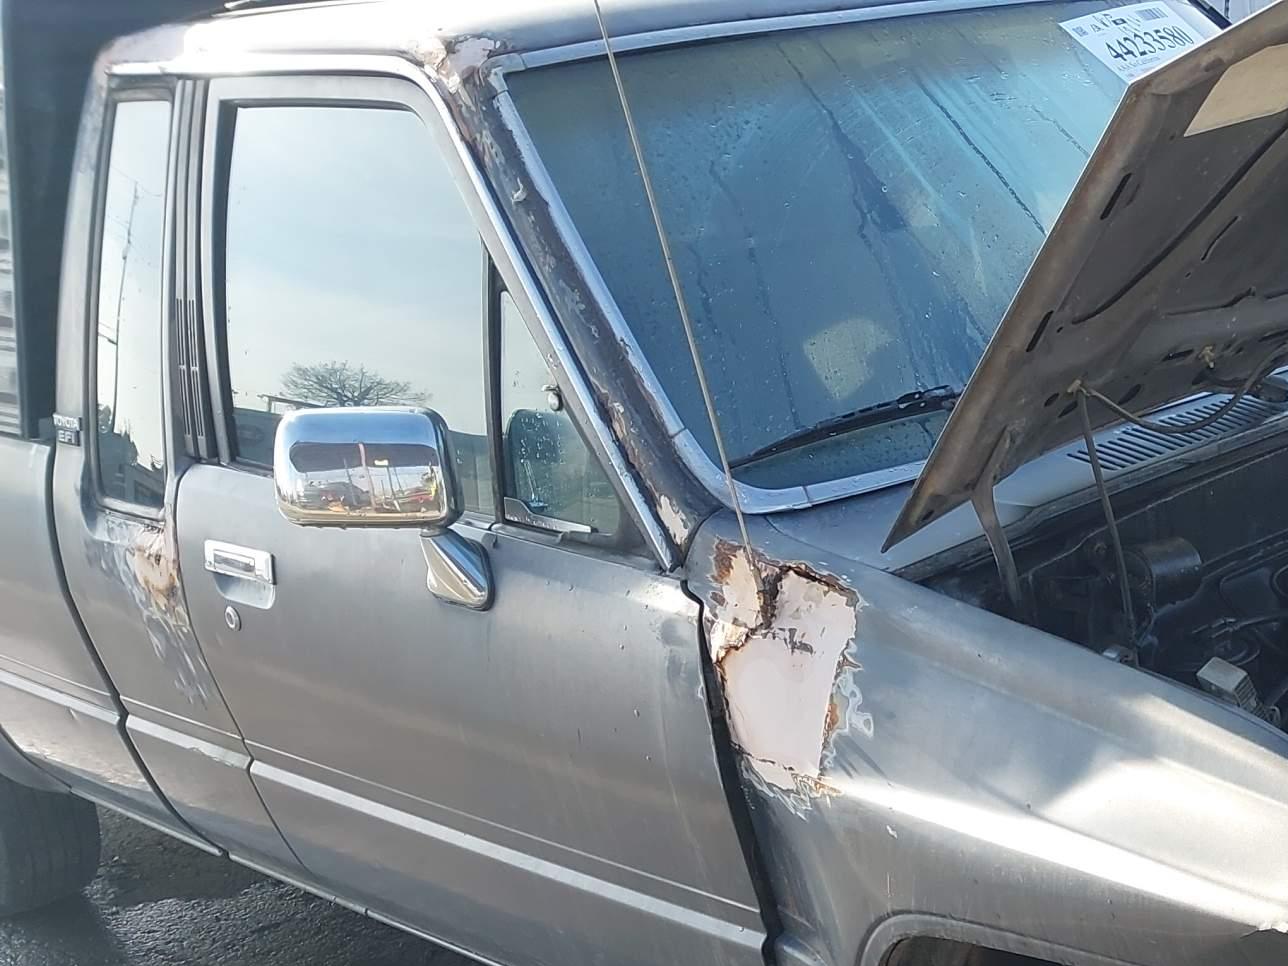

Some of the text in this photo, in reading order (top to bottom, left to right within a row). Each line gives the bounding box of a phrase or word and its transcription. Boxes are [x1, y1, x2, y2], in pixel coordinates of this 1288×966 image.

[1105, 25, 1195, 62] 44233580
[52, 413, 80, 431] TOYOTA
[58, 430, 76, 444] EFI
